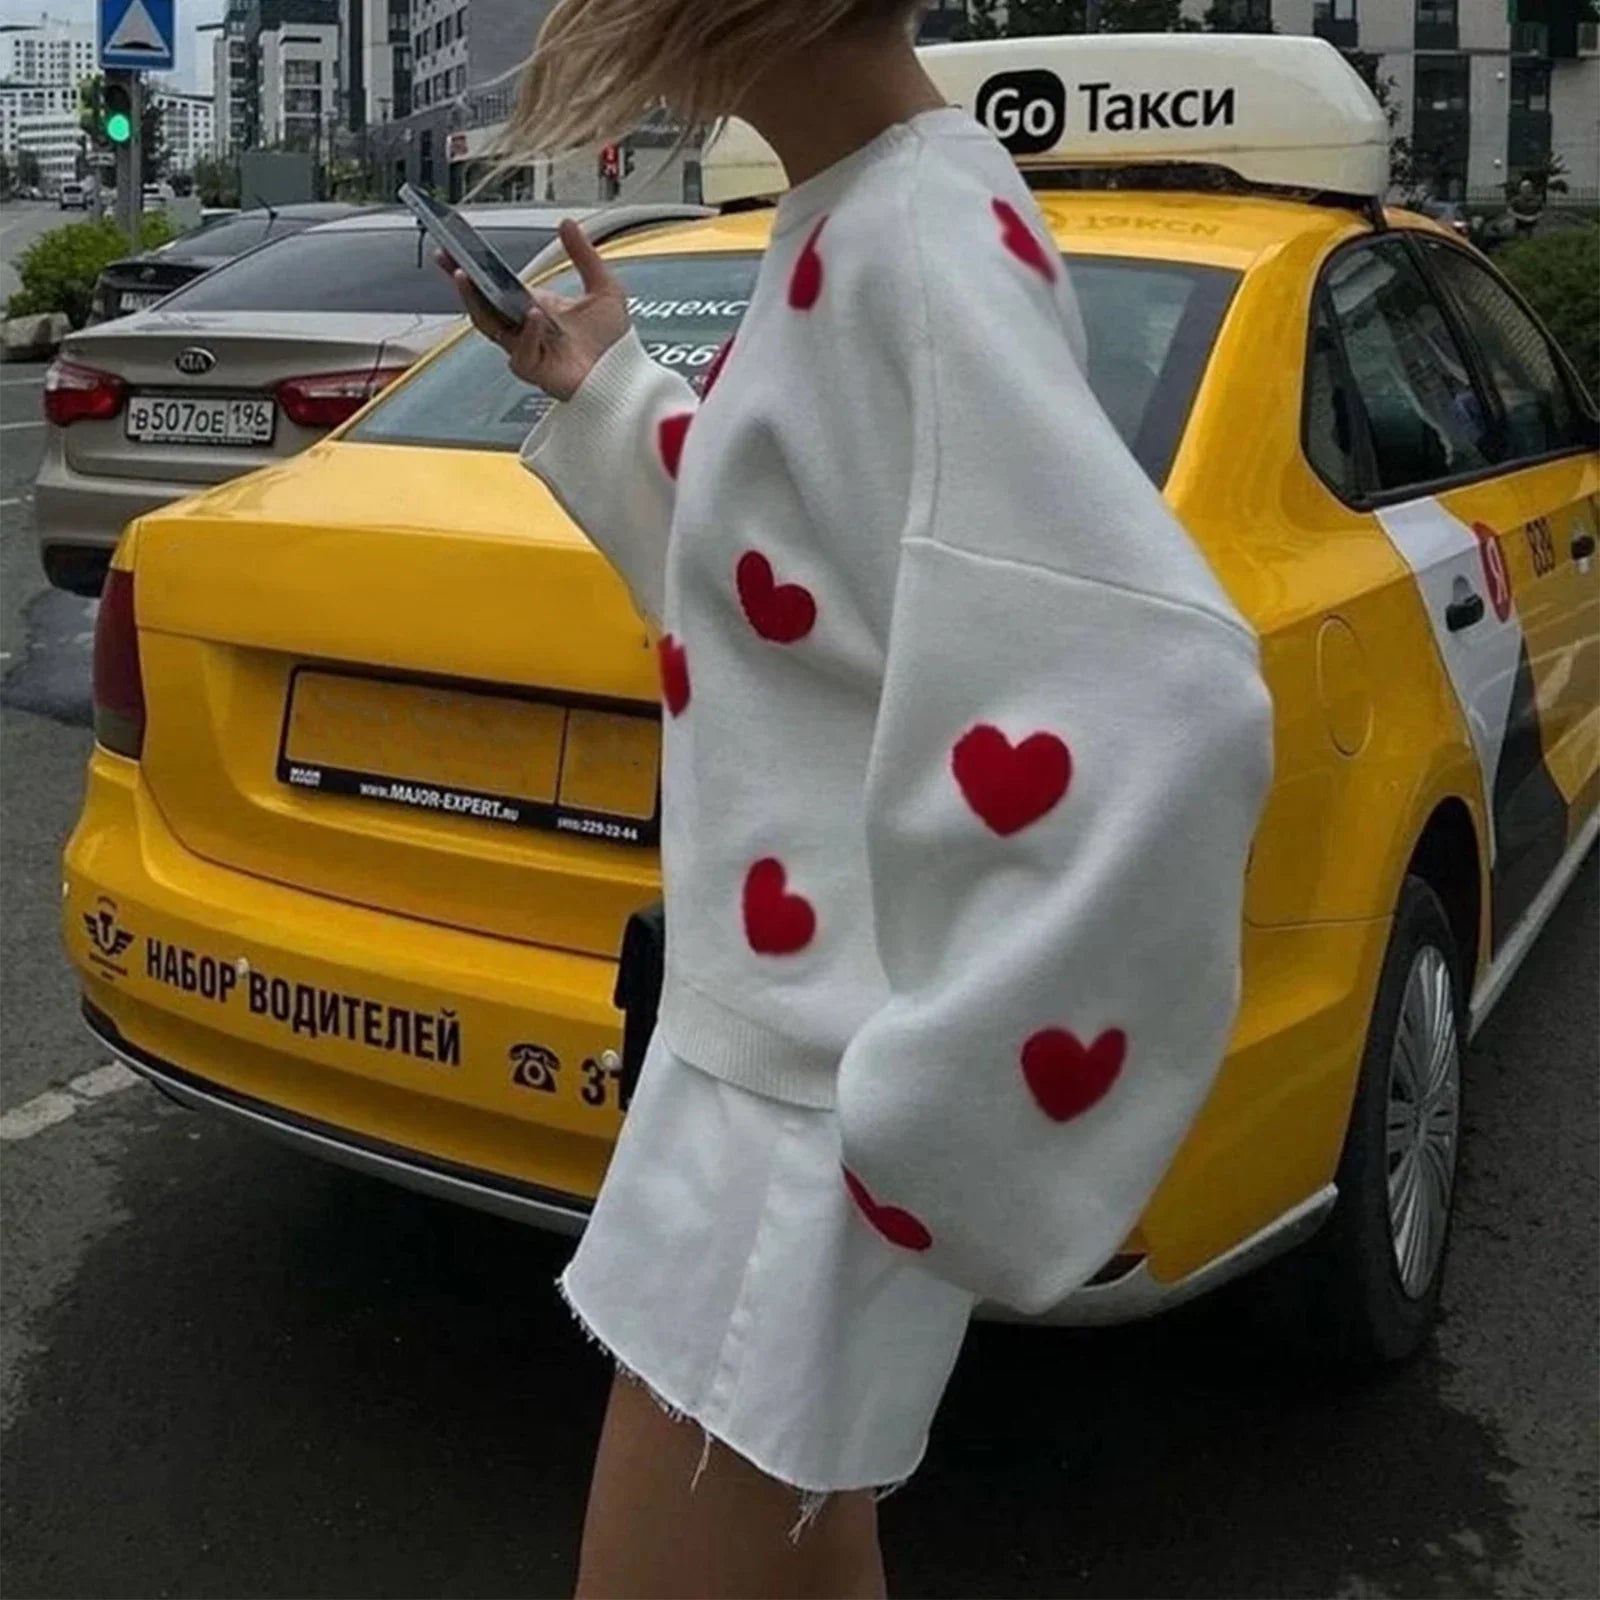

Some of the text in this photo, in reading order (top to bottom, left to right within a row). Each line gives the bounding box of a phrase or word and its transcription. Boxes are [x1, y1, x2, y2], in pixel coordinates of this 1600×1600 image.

[985, 82, 1236, 139] Go Такси
[179, 354, 206, 371] KIA
[232, 404, 268, 426] 196
[146, 938, 462, 1066] НАБОР ВОДИТЕЛЕЙ
